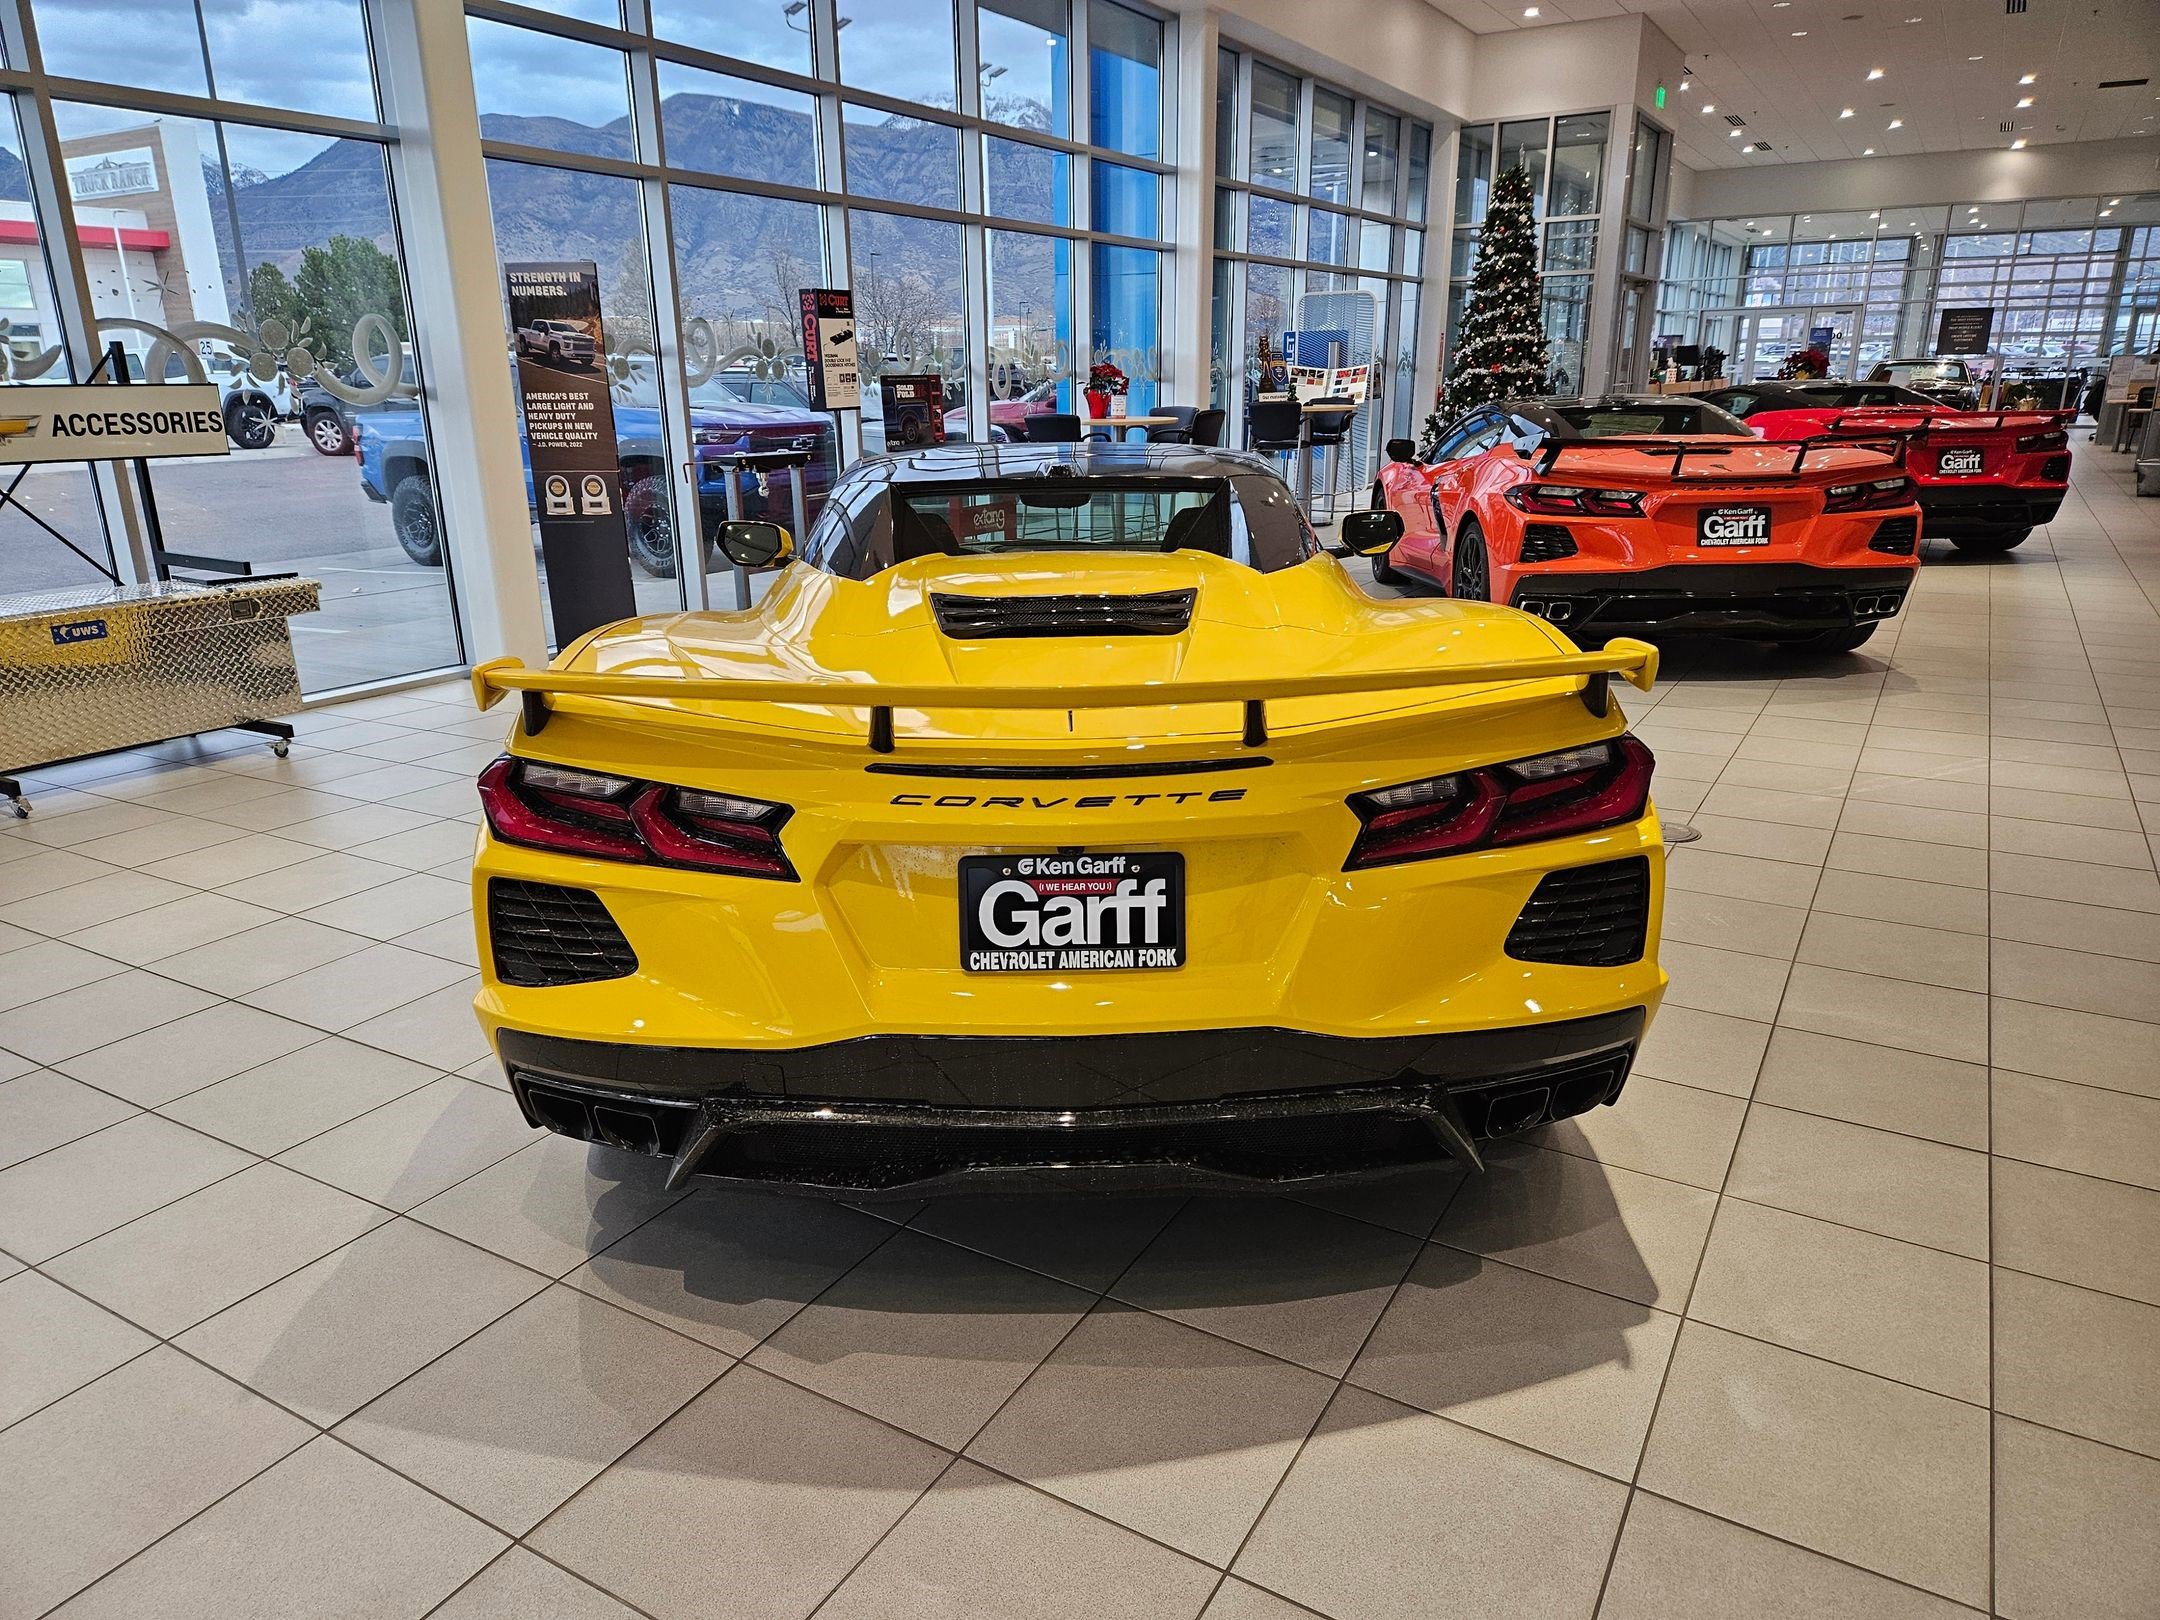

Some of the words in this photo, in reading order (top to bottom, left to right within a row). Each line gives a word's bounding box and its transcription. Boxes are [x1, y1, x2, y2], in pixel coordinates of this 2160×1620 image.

[71, 172, 110, 194] TRUCK
[109, 166, 152, 190] RANCH
[509, 271, 567, 283] STRENGTH
[569, 271, 581, 283] IN
[511, 285, 568, 297] NUMBERS.
[828, 294, 849, 307] CURT
[803, 313, 819, 362] CURT
[200, 341, 212, 355] 25
[896, 384, 914, 392] SOLID
[526, 392, 568, 400] AMERICA'S
[569, 392, 589, 400] BEST
[526, 402, 552, 410] LARGE
[553, 402, 576, 410] LIGHT
[577, 402, 594, 410] AND
[527, 412, 553, 420] HEAVY
[555, 412, 576, 420] DUTY
[52, 410, 224, 438] ACCESSORIES
[529, 422, 563, 430] PICKUPS
[564, 422, 573, 430] IN
[574, 422, 593, 430] NEW
[530, 432, 564, 440] VEHICLE
[564, 432, 598, 441] QUALITY
[1941, 454, 1981, 470] Garff
[973, 508, 1005, 529] extang
[1703, 514, 1766, 539] Garff
[1700, 538, 1730, 546] CHEVROLET
[72, 625, 99, 637] UWS
[890, 788, 1248, 809] CORVETTE
[1036, 857, 1075, 875] Ken
[1076, 856, 1126, 875] Garff
[1045, 882, 1060, 891] WE
[1061, 882, 1087, 891] HEAR
[1087, 882, 1106, 891] YOU
[978, 878, 1167, 948] Garff
[970, 951, 1055, 971] CHEVROLET
[1058, 949, 1136, 969] AMERICAN
[1138, 948, 1177, 967] FORK
